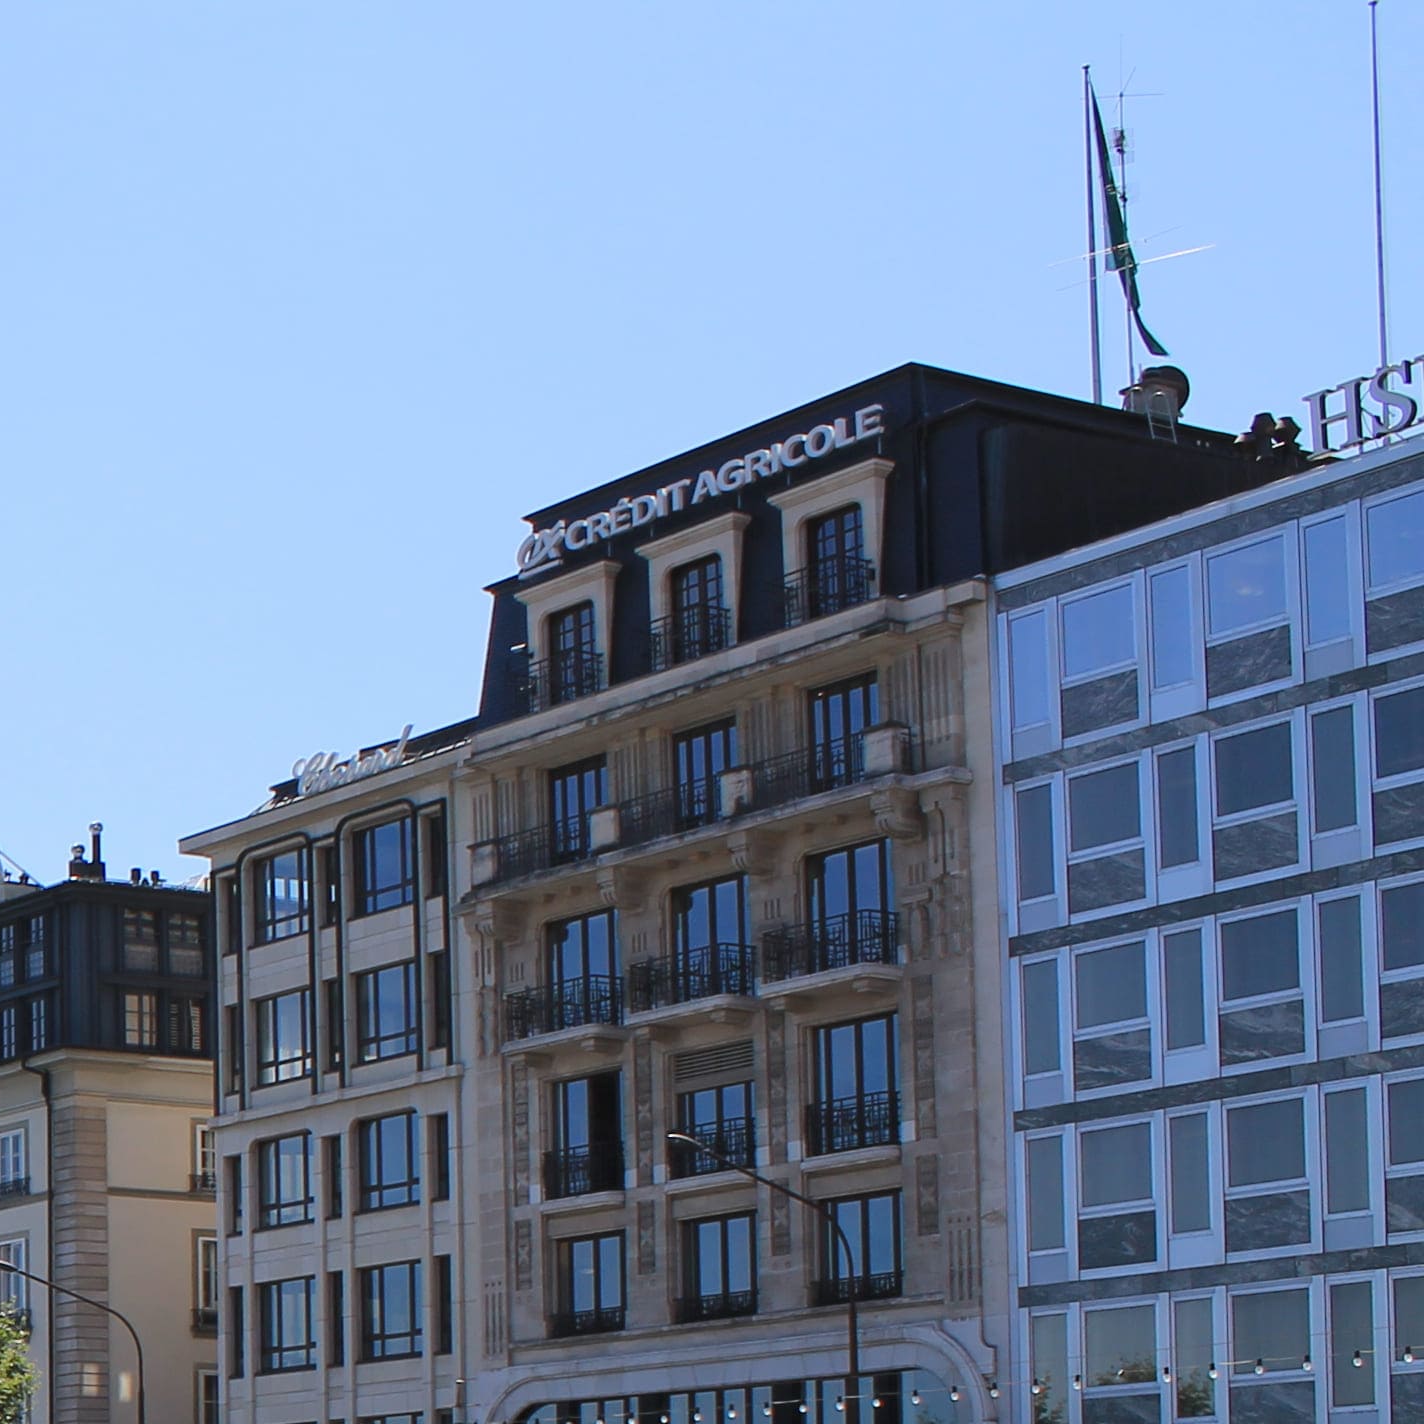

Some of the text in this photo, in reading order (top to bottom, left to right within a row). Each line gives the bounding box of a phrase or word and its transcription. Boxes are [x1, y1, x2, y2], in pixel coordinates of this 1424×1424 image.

[1302, 354, 1424, 461] HS
[563, 477, 693, 552] CRÉDIT
[691, 403, 886, 505] AGRICOLE
